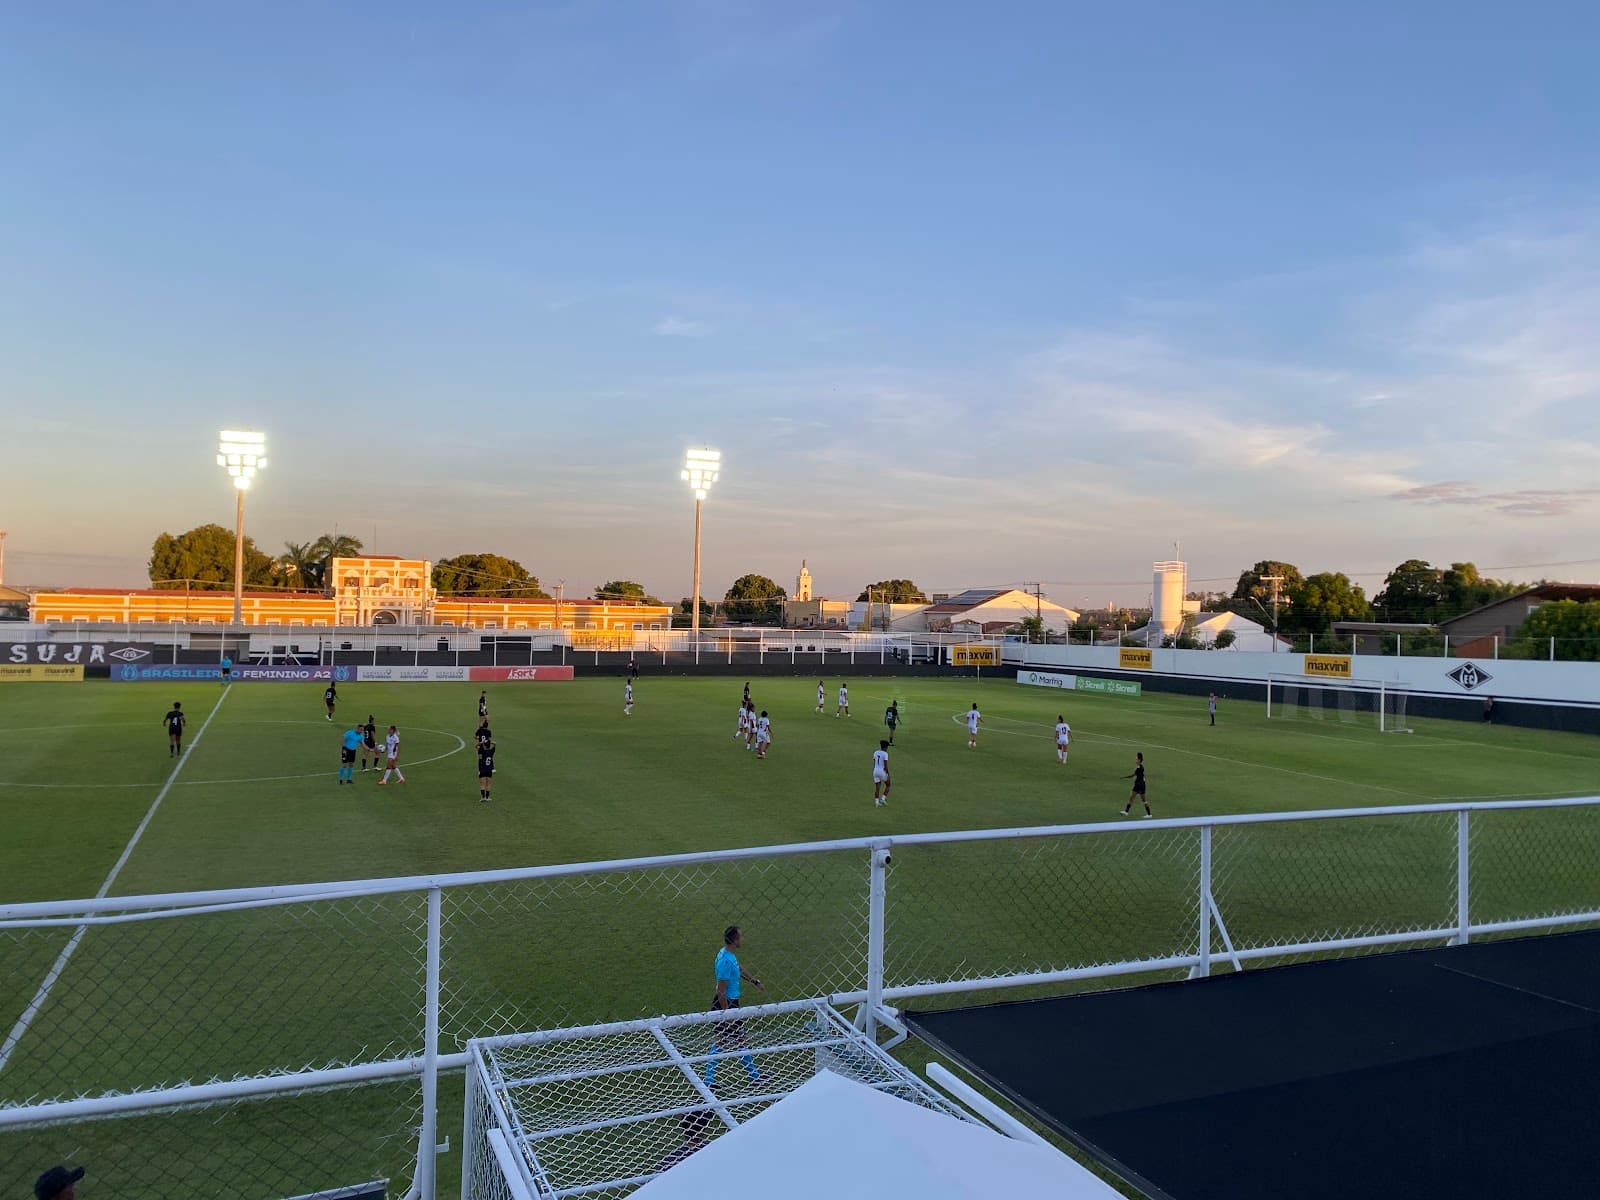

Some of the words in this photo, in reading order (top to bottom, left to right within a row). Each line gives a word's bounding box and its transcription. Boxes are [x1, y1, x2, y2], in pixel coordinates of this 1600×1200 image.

[1307, 660, 1349, 673] maxvinil
[243, 670, 310, 678] FEMININO
[313, 670, 332, 679] A2
[1039, 675, 1063, 688] Marfrig
[172, 716, 178, 726] 4
